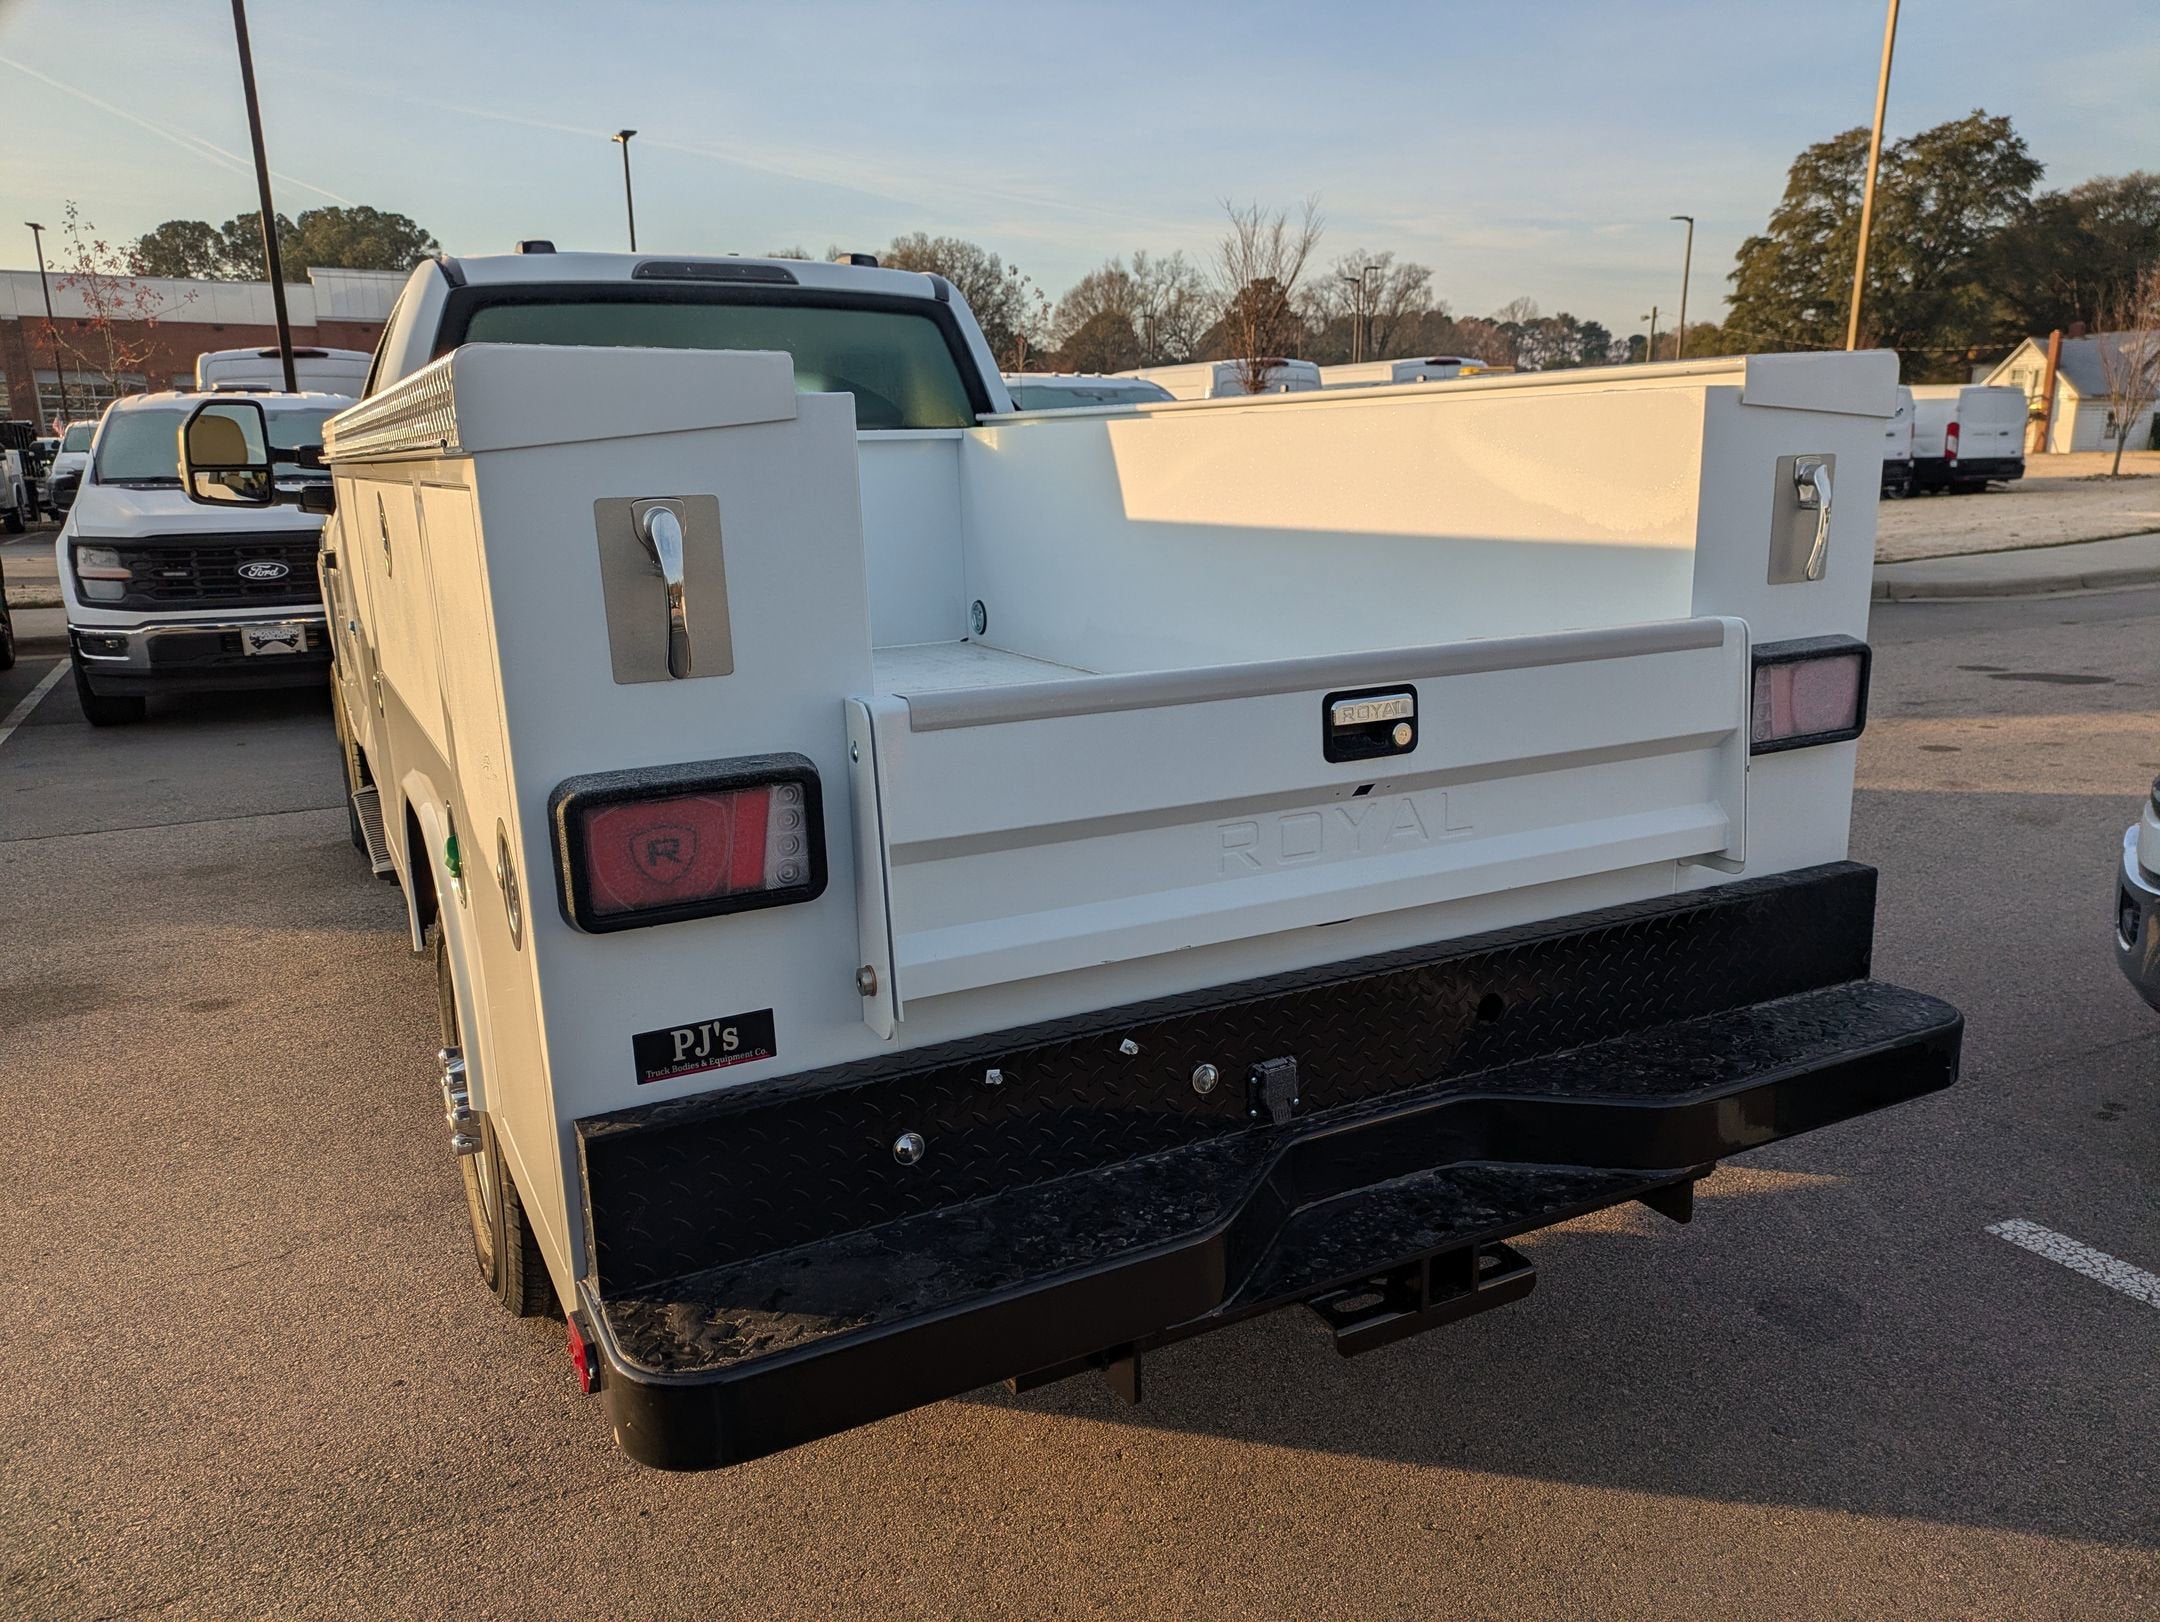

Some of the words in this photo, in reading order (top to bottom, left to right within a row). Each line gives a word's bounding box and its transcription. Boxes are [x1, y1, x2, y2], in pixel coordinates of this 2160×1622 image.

[248, 565, 279, 577] Ford
[1343, 700, 1408, 722] ROYAL
[1216, 792, 1474, 876] ROYAL
[647, 837, 682, 867] R
[670, 1021, 739, 1062] PJ's
[646, 1066, 670, 1079] Truck
[672, 1061, 700, 1073] Bodies
[701, 1059, 708, 1067] &
[709, 1050, 753, 1067] Equipment
[754, 1047, 768, 1056] Co.
